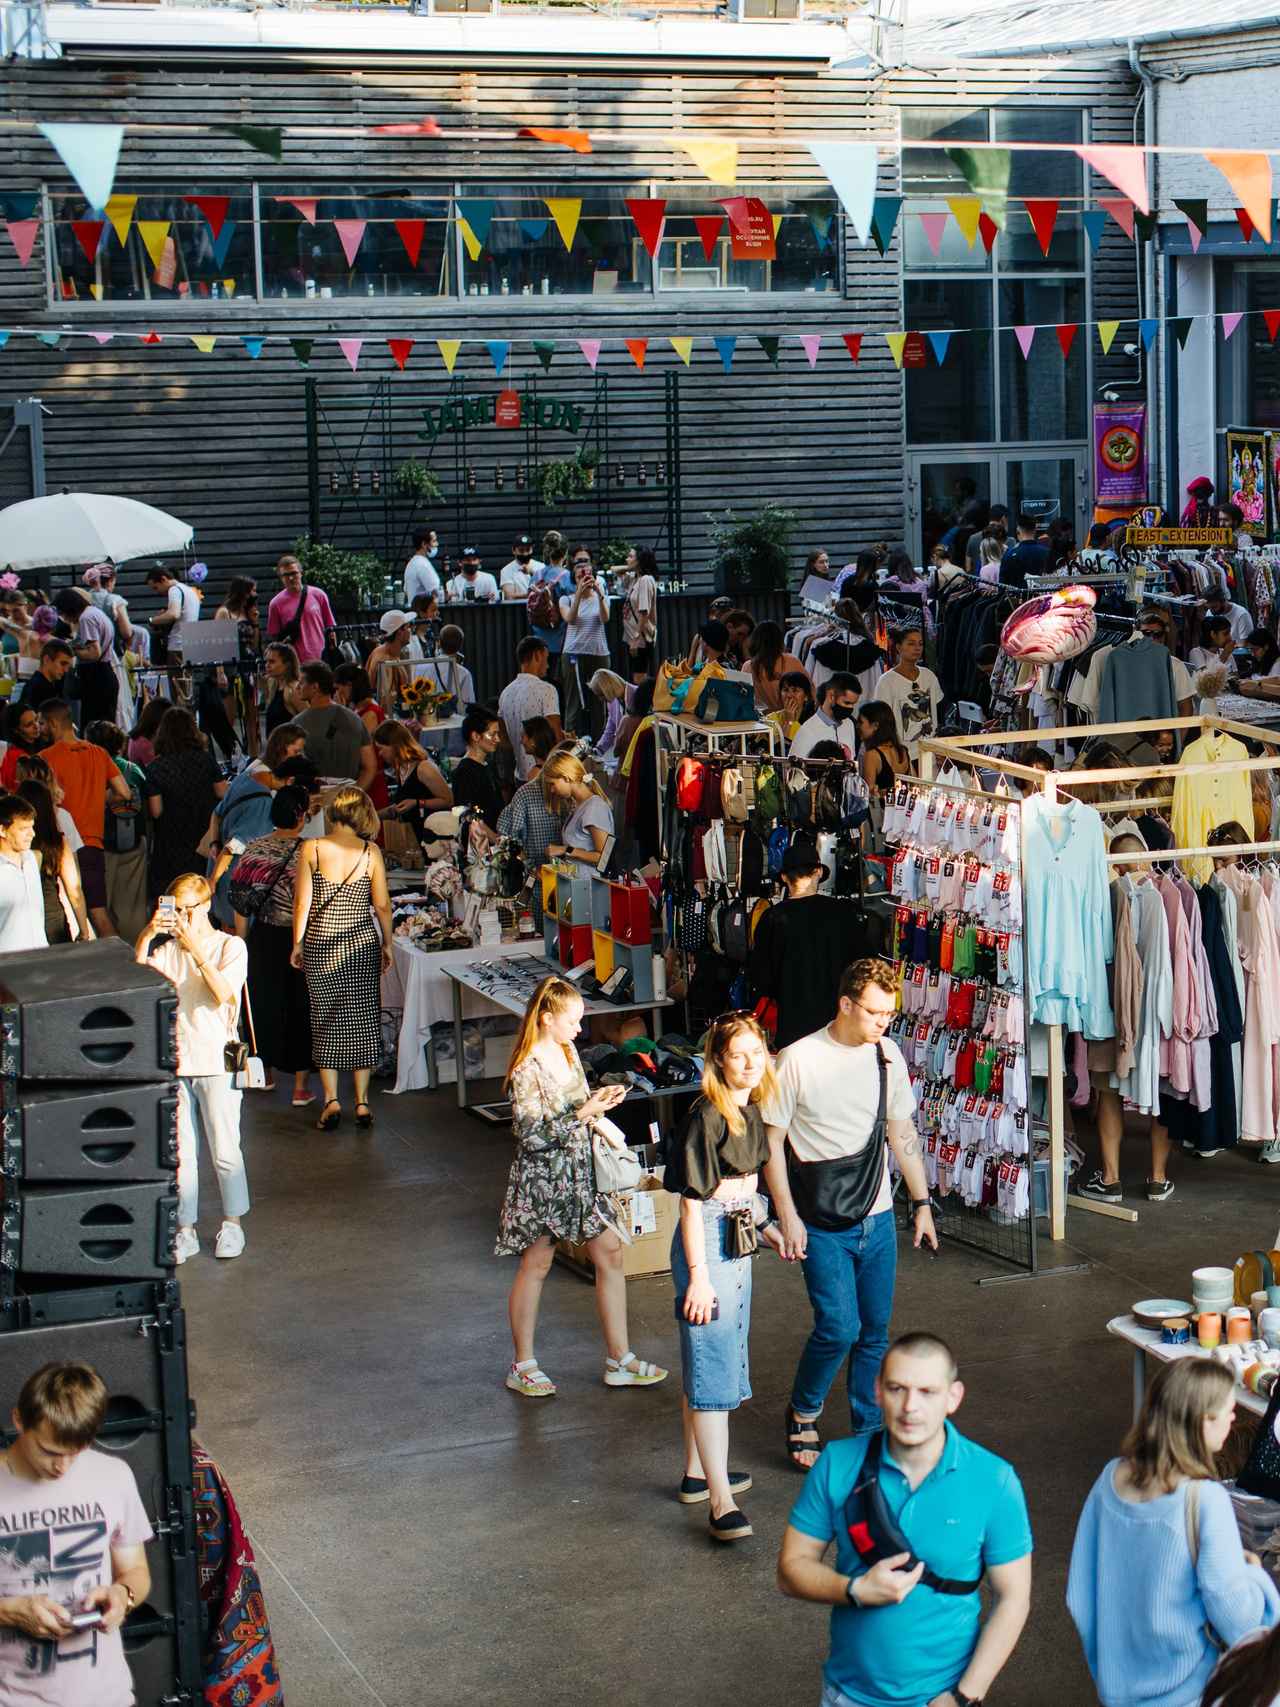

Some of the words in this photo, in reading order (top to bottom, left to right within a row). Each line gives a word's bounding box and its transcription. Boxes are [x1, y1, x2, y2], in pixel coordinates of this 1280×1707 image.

[418, 395, 585, 440] JAMSON
[1136, 530, 1162, 542] EAST
[1169, 530, 1223, 542] EXTENSION
[0, 1502, 106, 1533] ALIFORNIA
